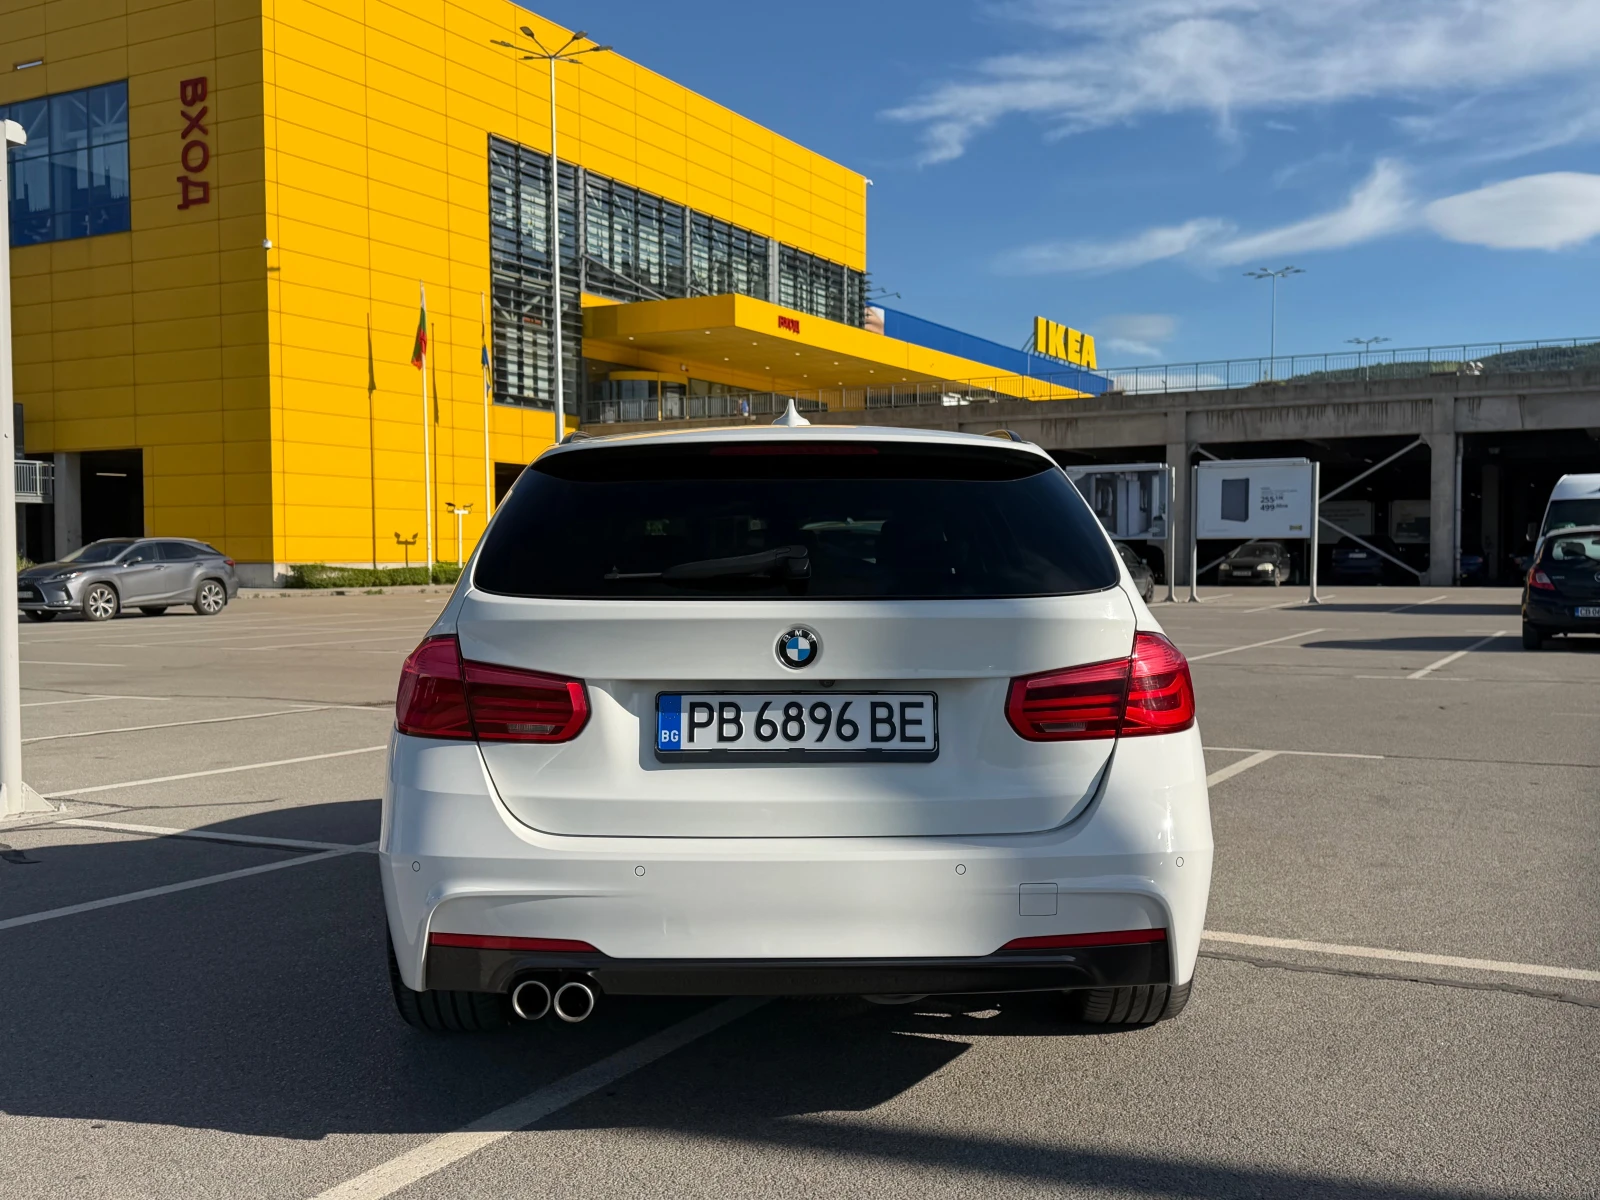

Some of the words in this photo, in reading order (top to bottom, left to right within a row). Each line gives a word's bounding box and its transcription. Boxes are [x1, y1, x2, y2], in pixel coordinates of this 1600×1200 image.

[177, 76, 210, 210] ВХОД
[1034, 315, 1098, 370] IKEA
[782, 629, 815, 643] BMW
[660, 729, 679, 743] BG
[687, 701, 744, 743] PB
[754, 701, 860, 743] 6896
[870, 701, 926, 743] BE
